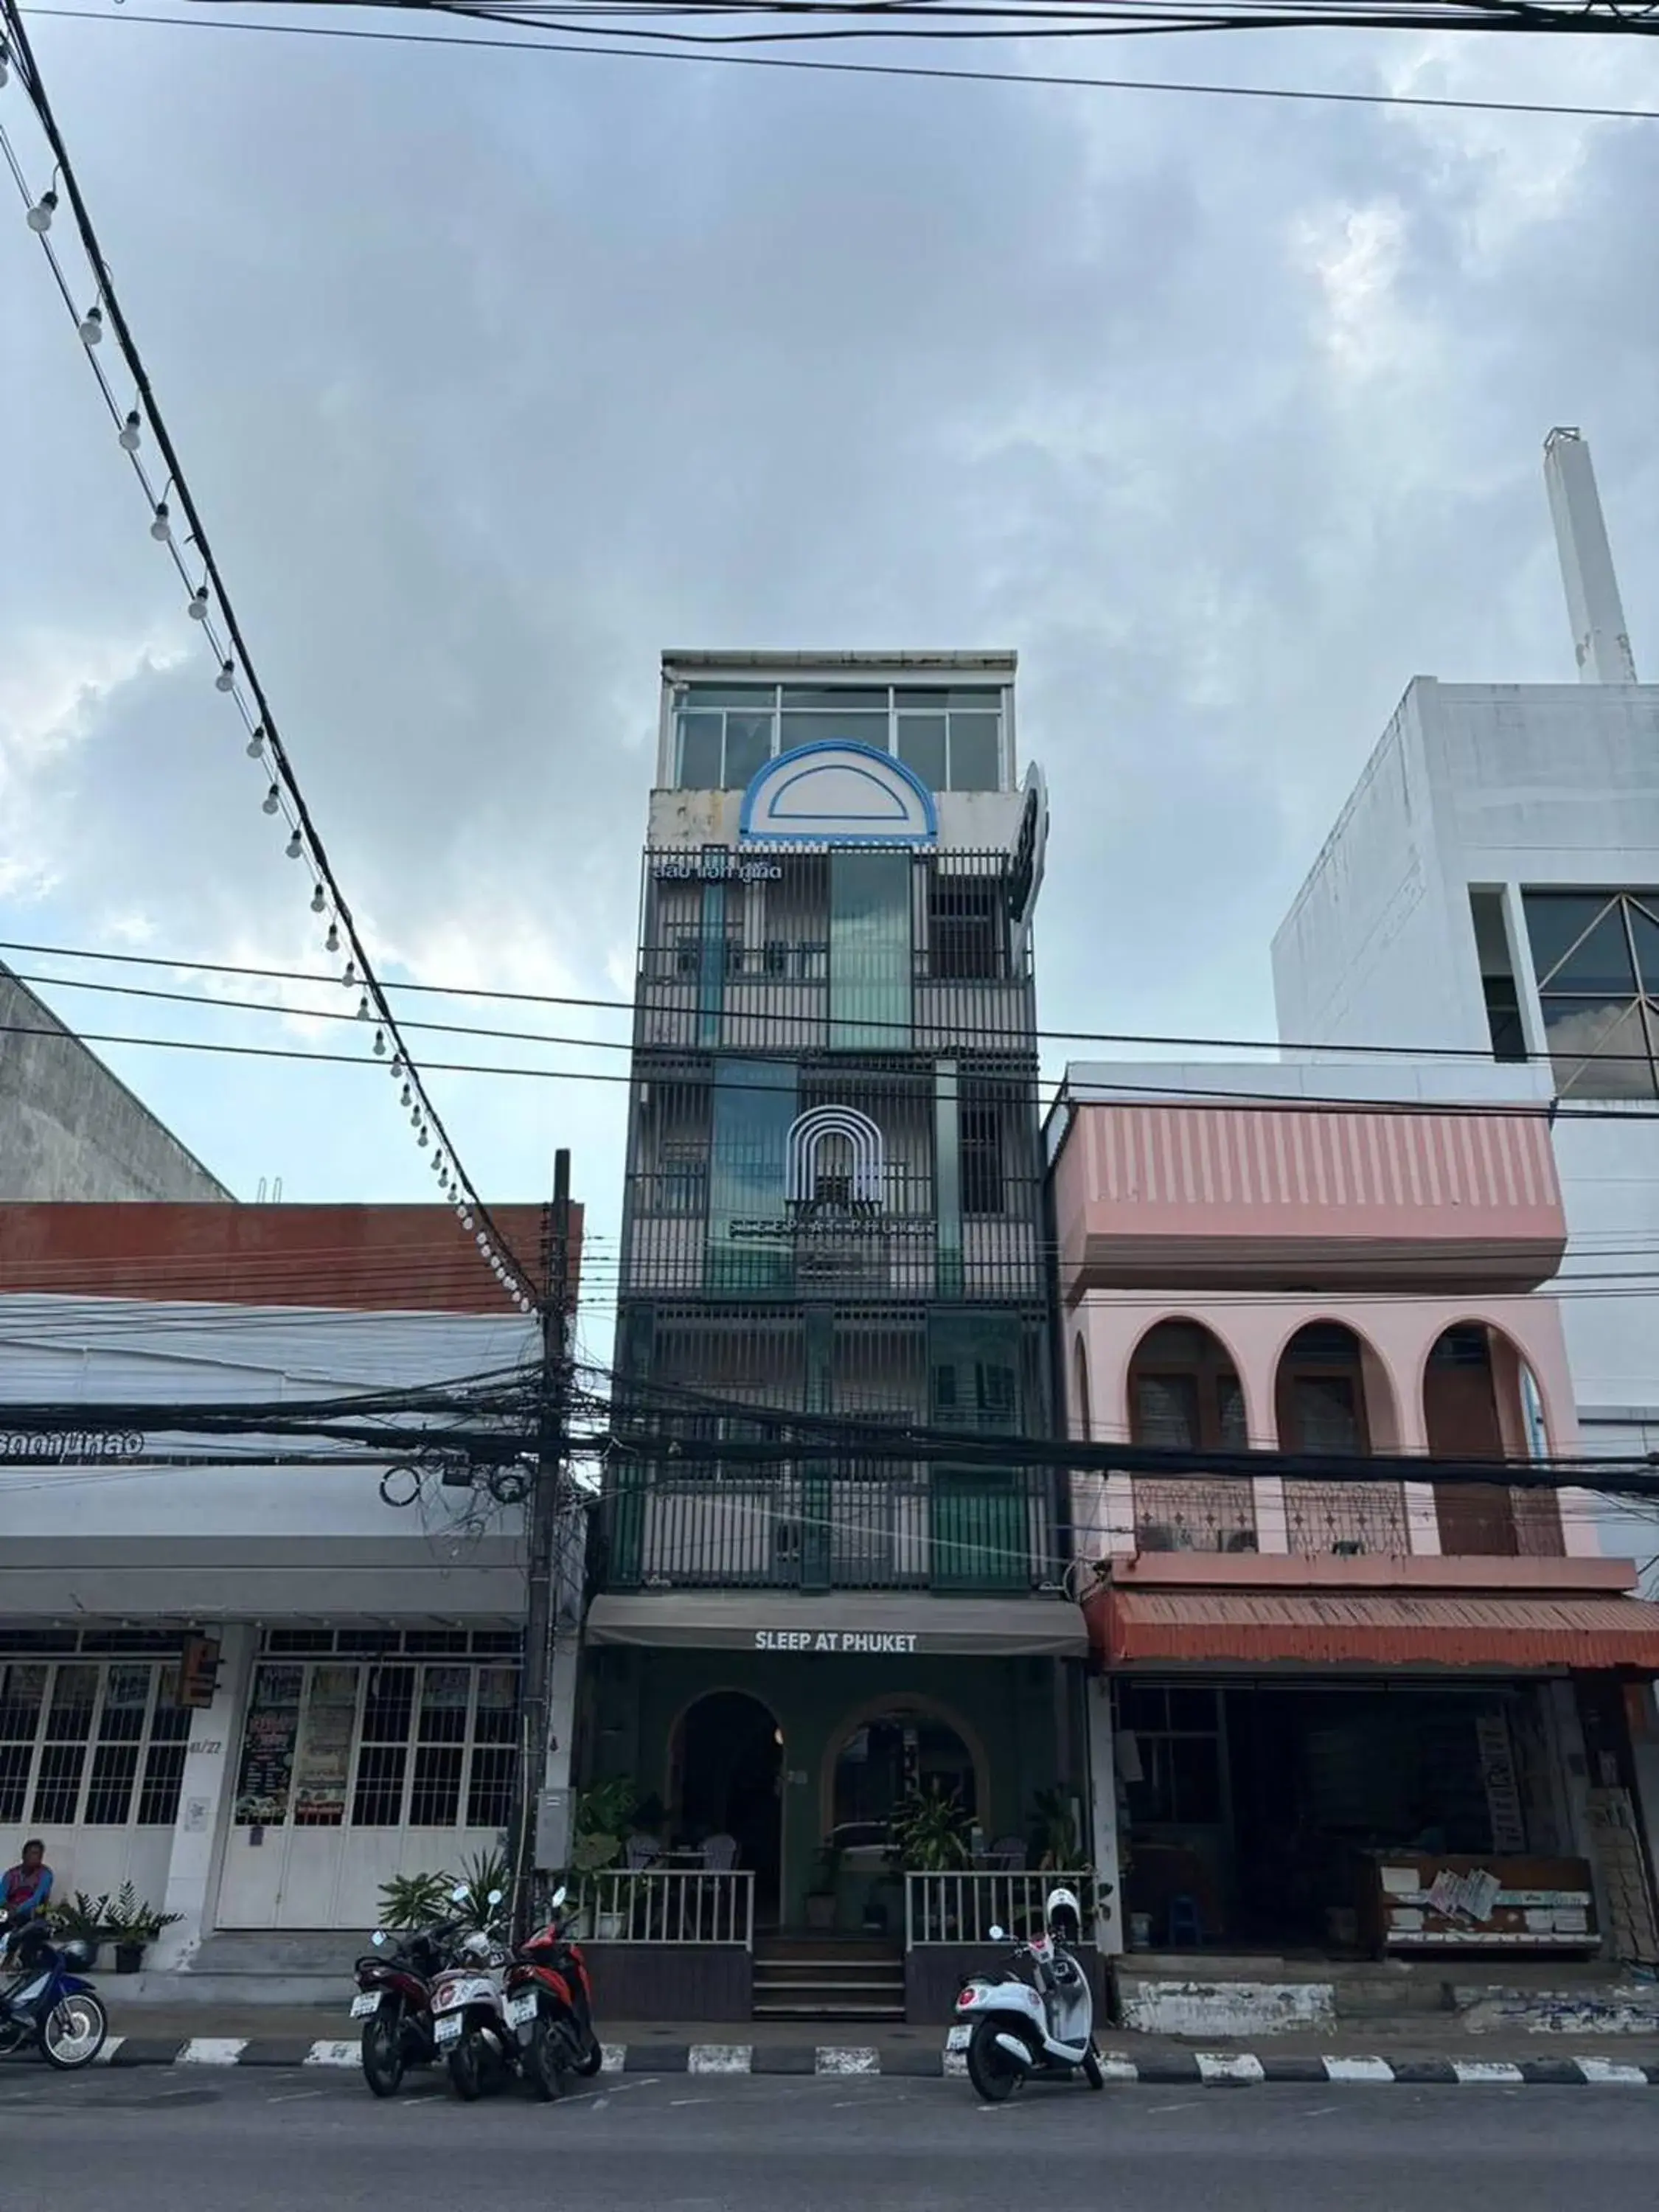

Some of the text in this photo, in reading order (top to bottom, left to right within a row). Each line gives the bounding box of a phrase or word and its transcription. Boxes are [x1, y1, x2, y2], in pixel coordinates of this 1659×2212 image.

[755, 1631, 917, 1652] SLEEP AT PHUKET
